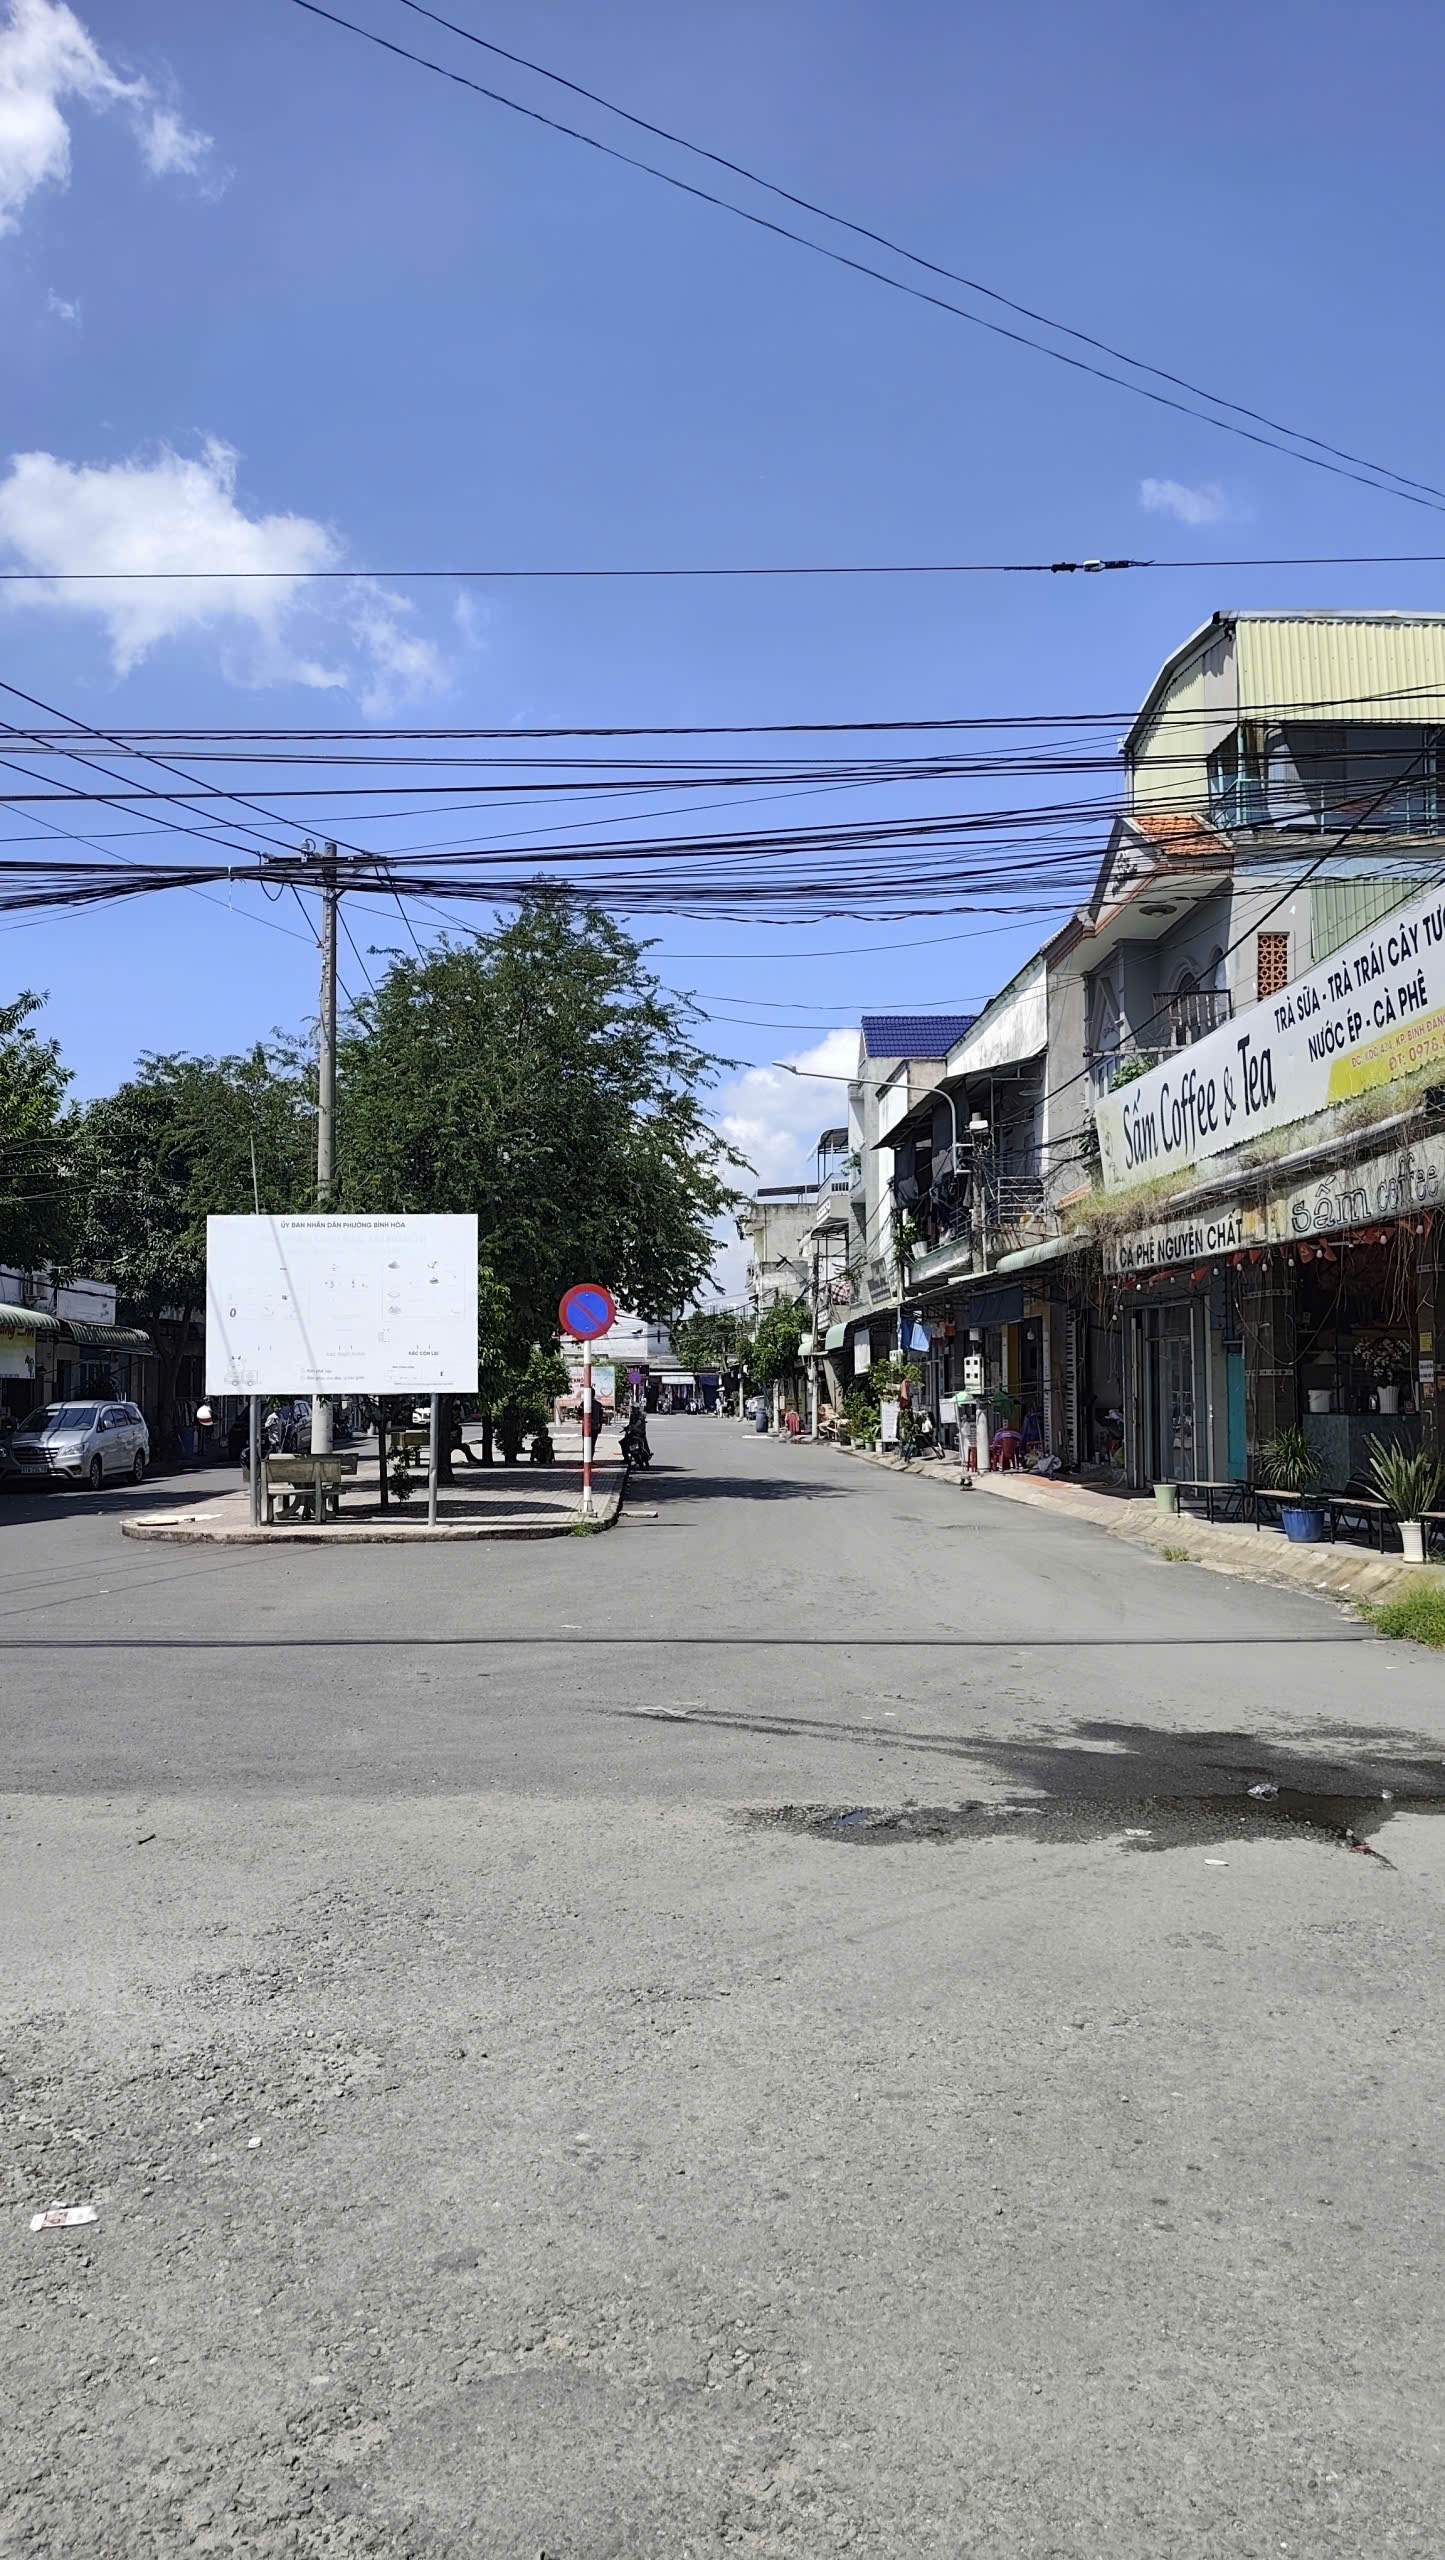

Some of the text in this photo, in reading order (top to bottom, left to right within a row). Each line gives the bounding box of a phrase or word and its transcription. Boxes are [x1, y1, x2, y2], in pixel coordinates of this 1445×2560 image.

[1274, 996, 1296, 1033] TRÀ
[1297, 986, 1320, 1021] SỮA
[1328, 960, 1353, 1003] TRÀ
[1353, 941, 1385, 987] TRÁI
[1387, 923, 1419, 966] CÂY
[1308, 1020, 1345, 1063] NƯỚC
[1347, 1008, 1363, 1042] ÉP
[1373, 987, 1396, 1028] CÀ
[1398, 968, 1428, 1017] PHÊ
[1123, 1033, 1277, 1170] Sấm Coffee & Tea
[306, 1220, 326, 1229] NHÂN
[327, 1220, 342, 1229] DÂN
[1292, 1151, 1439, 1233] sấm coffee
[1119, 1240, 1134, 1268] CÀ
[1136, 1235, 1155, 1265] PHÊ
[1157, 1225, 1203, 1262] NGUYÊN
[1207, 1208, 1243, 1250] CHẤT
